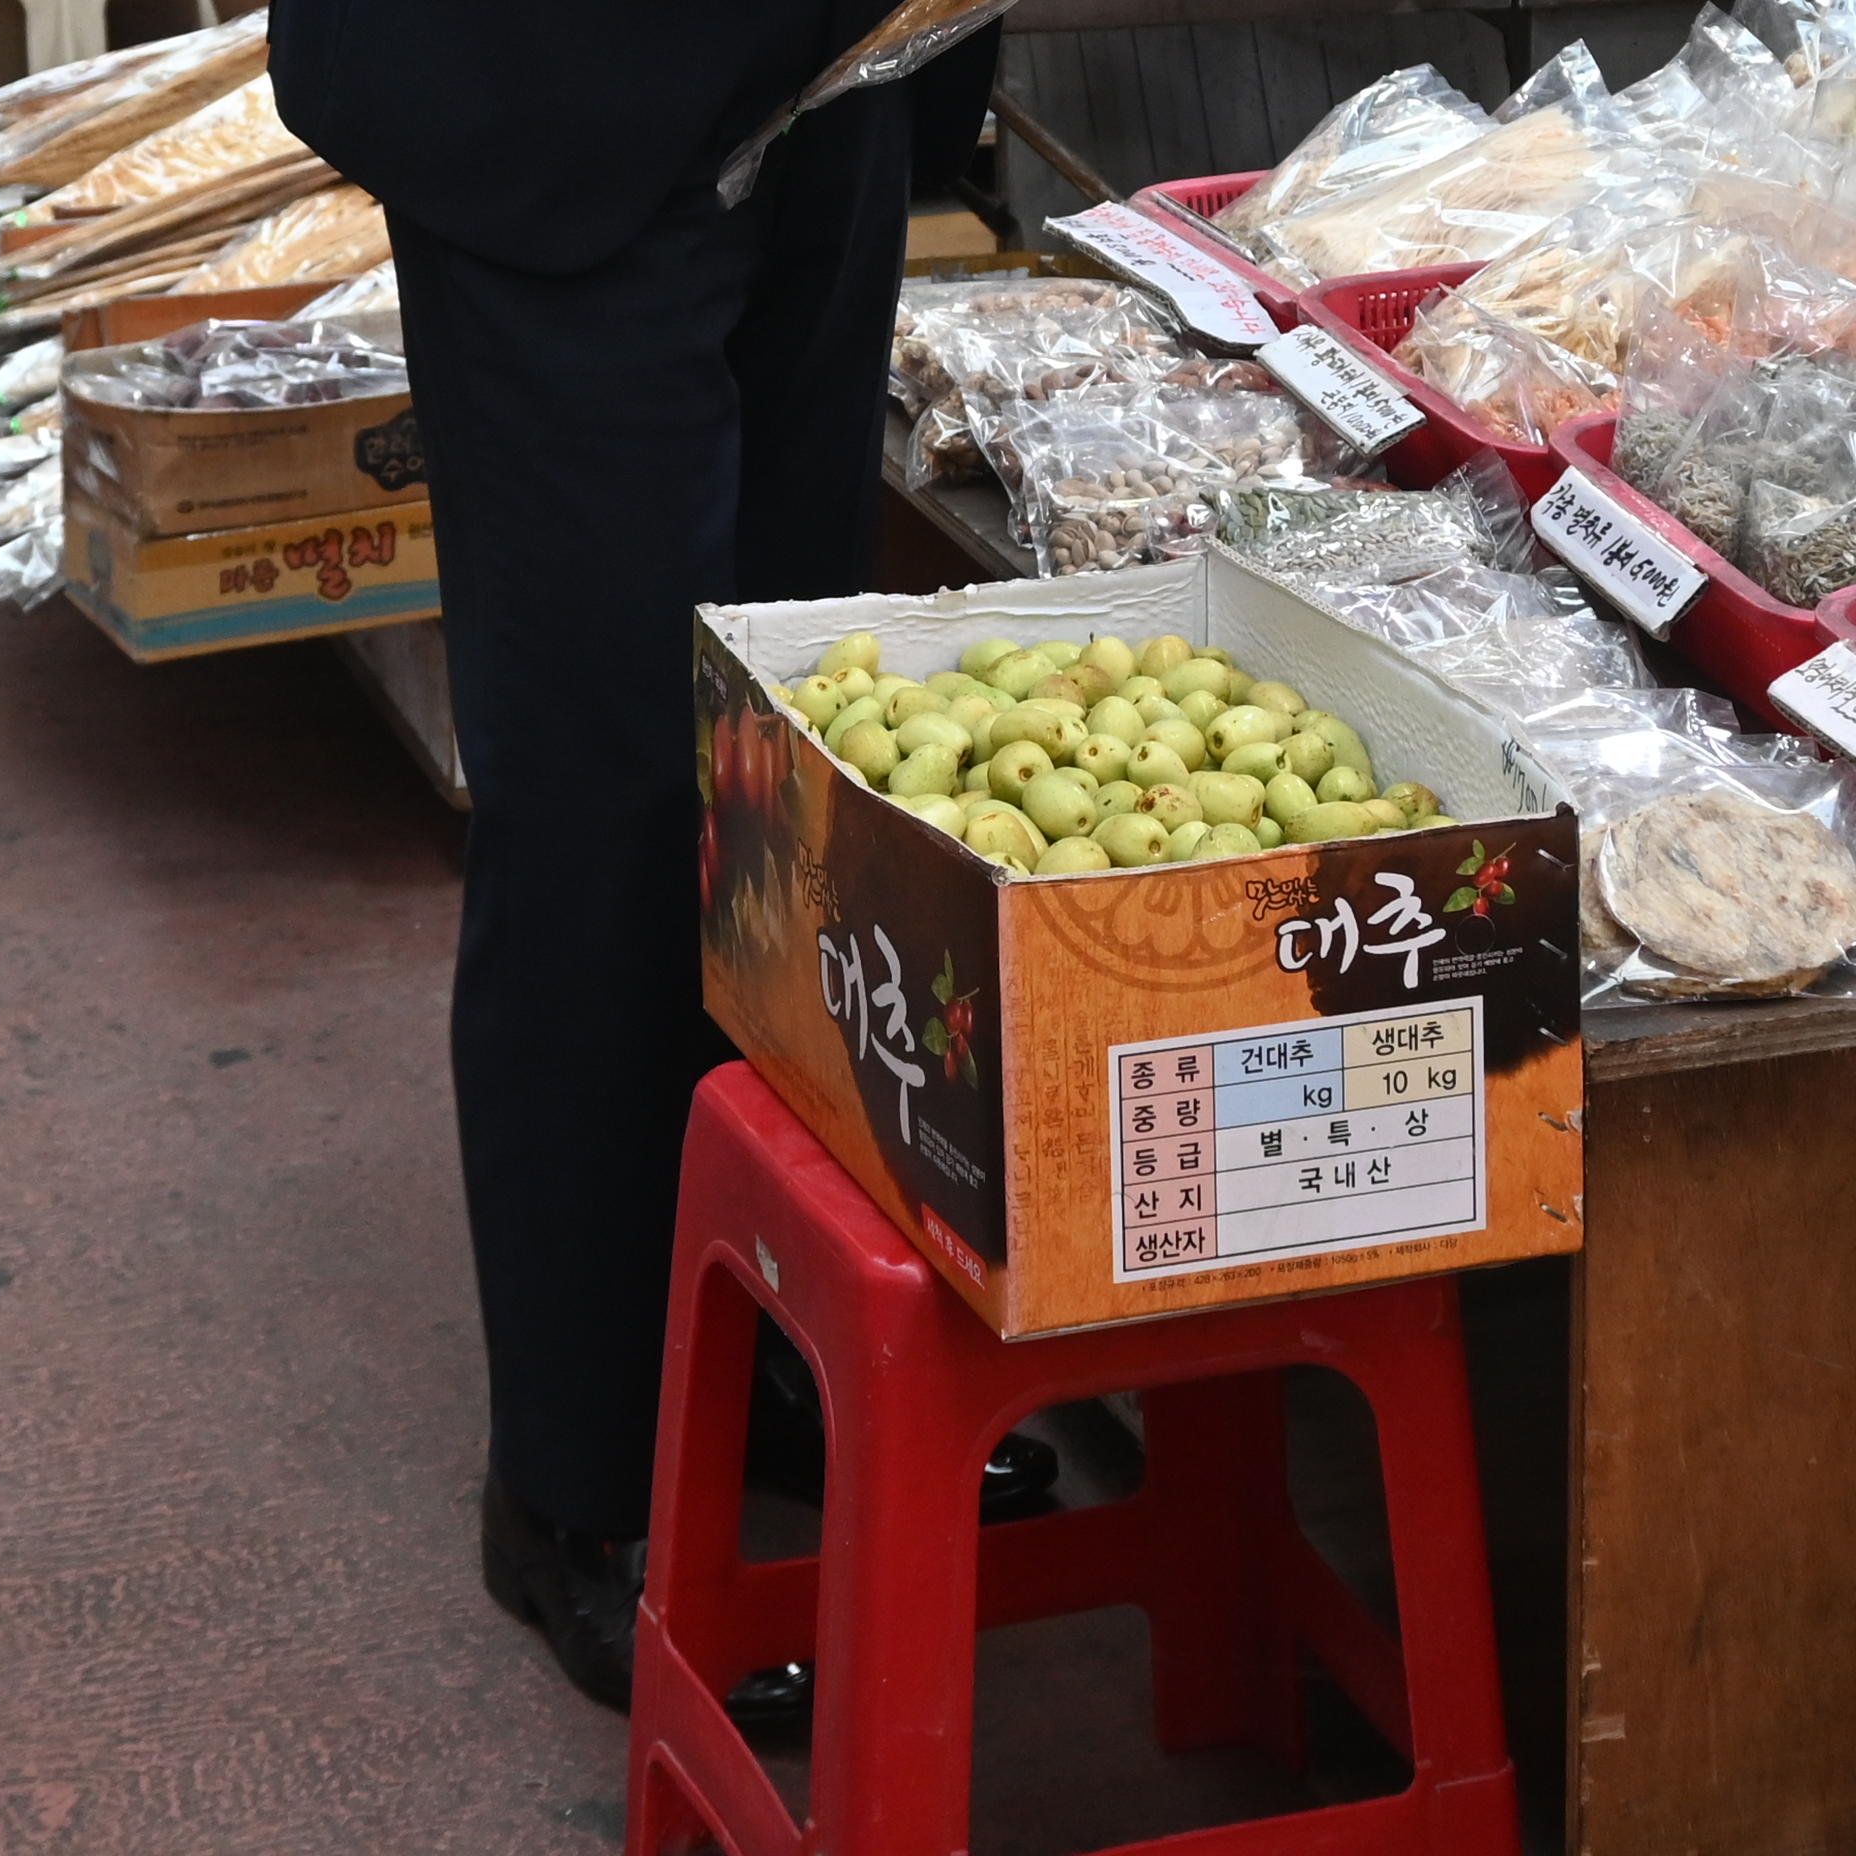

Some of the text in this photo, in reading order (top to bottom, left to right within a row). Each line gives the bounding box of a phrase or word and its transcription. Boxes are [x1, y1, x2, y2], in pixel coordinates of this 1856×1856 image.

[1542, 483, 1576, 520] 각종
[283, 521, 395, 599] 멸치
[1246, 876, 1318, 921] 맛있는
[1277, 872, 1446, 989] 대추
[818, 923, 926, 1145] 대추
[1241, 1042, 1314, 1075] 건대추
[1371, 1021, 1444, 1057] 생대추
[1304, 1085, 1333, 1110] kg
[1382, 1069, 1408, 1095] 10
[1428, 1067, 1458, 1091] kg
[1260, 1128, 1284, 1158] 별
[1327, 1119, 1352, 1147] 특
[1406, 1109, 1429, 1137] 상
[1299, 1156, 1392, 1193] 국내산
[1136, 1227, 1205, 1264] 생산자
